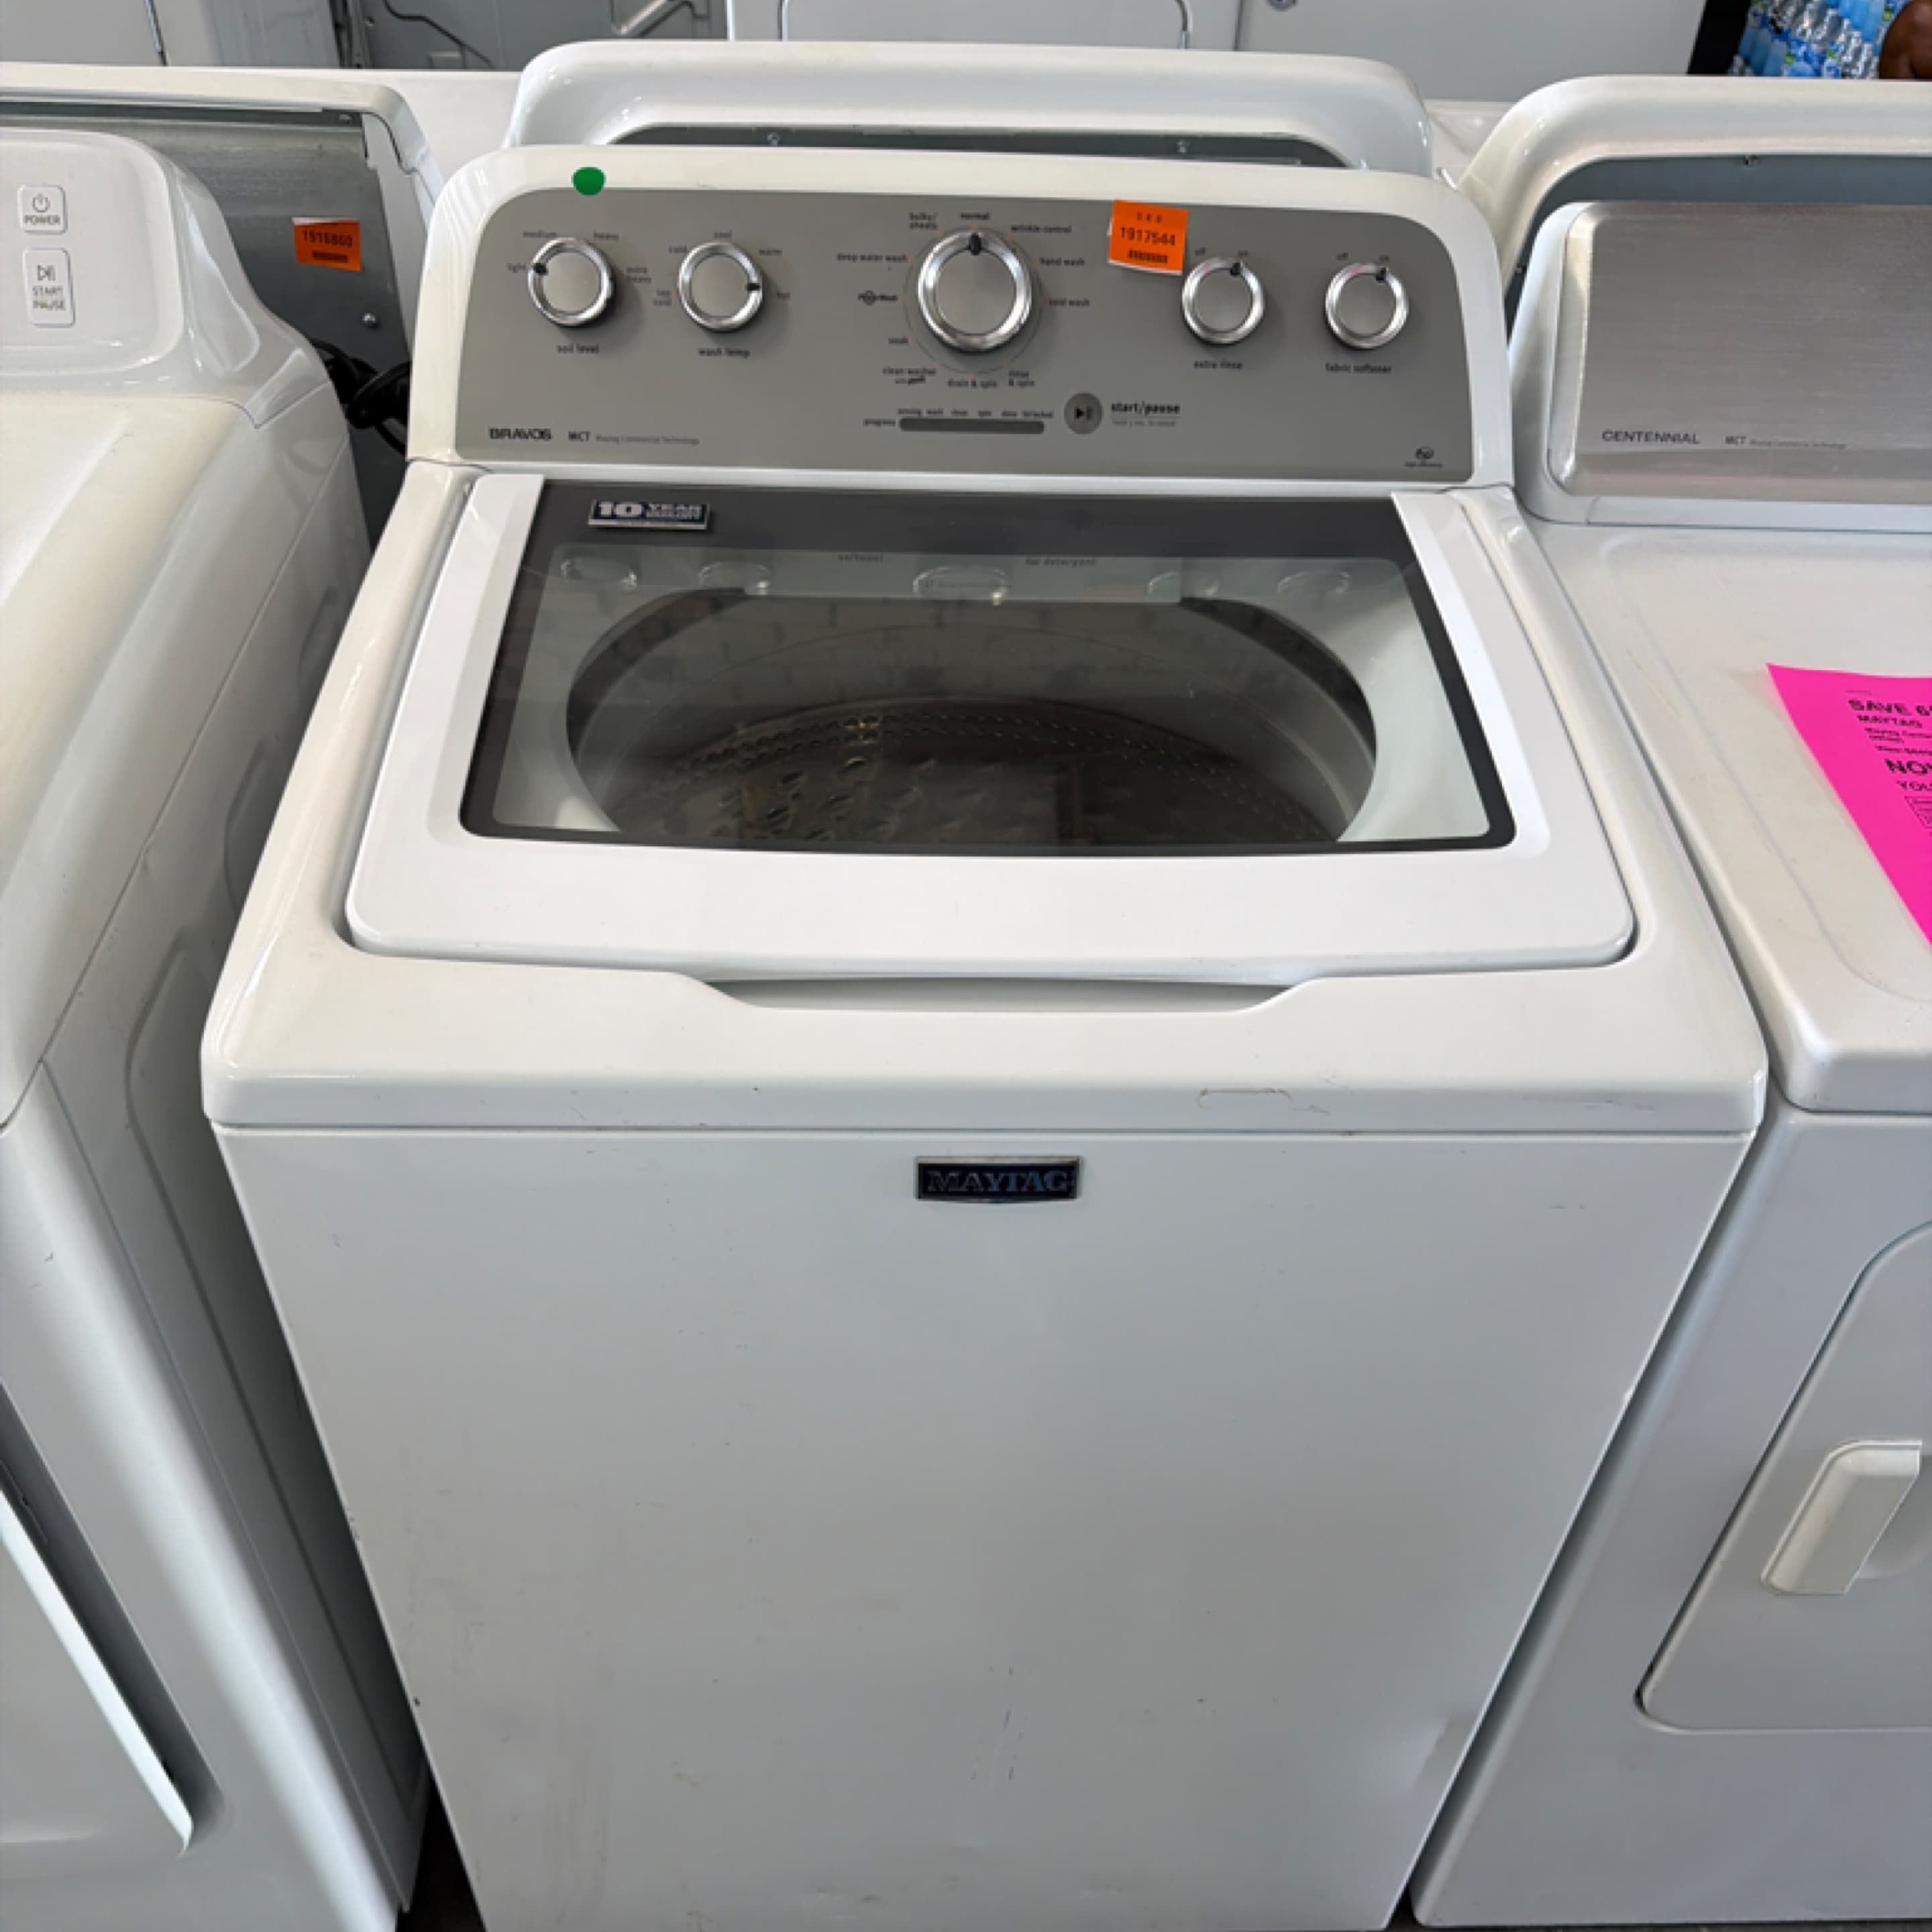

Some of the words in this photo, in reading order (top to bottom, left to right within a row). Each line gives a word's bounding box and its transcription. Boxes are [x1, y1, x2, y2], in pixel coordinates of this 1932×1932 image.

[23, 215, 61, 226] POWER
[32, 285, 64, 297] START
[32, 299, 66, 311] PAUSE
[556, 343, 574, 355] soil
[576, 343, 600, 355] level
[699, 346, 722, 358] wash
[724, 347, 751, 359] temp
[1193, 360, 1218, 371] extra
[1219, 360, 1243, 371] rinse
[1325, 362, 1352, 374] fabric
[1353, 362, 1392, 375] softener
[1110, 400, 1181, 417] start/pause
[489, 428, 553, 441] BRAVOS
[568, 430, 591, 443] MCT
[1601, 429, 1701, 445] CENTENNIAL
[1725, 435, 1747, 445] MCT
[598, 500, 643, 518] 10
[1848, 699, 1911, 716] SAVE
[1857, 714, 1923, 729] MAYTAG
[927, 1169, 1069, 1192] MAYTAG
